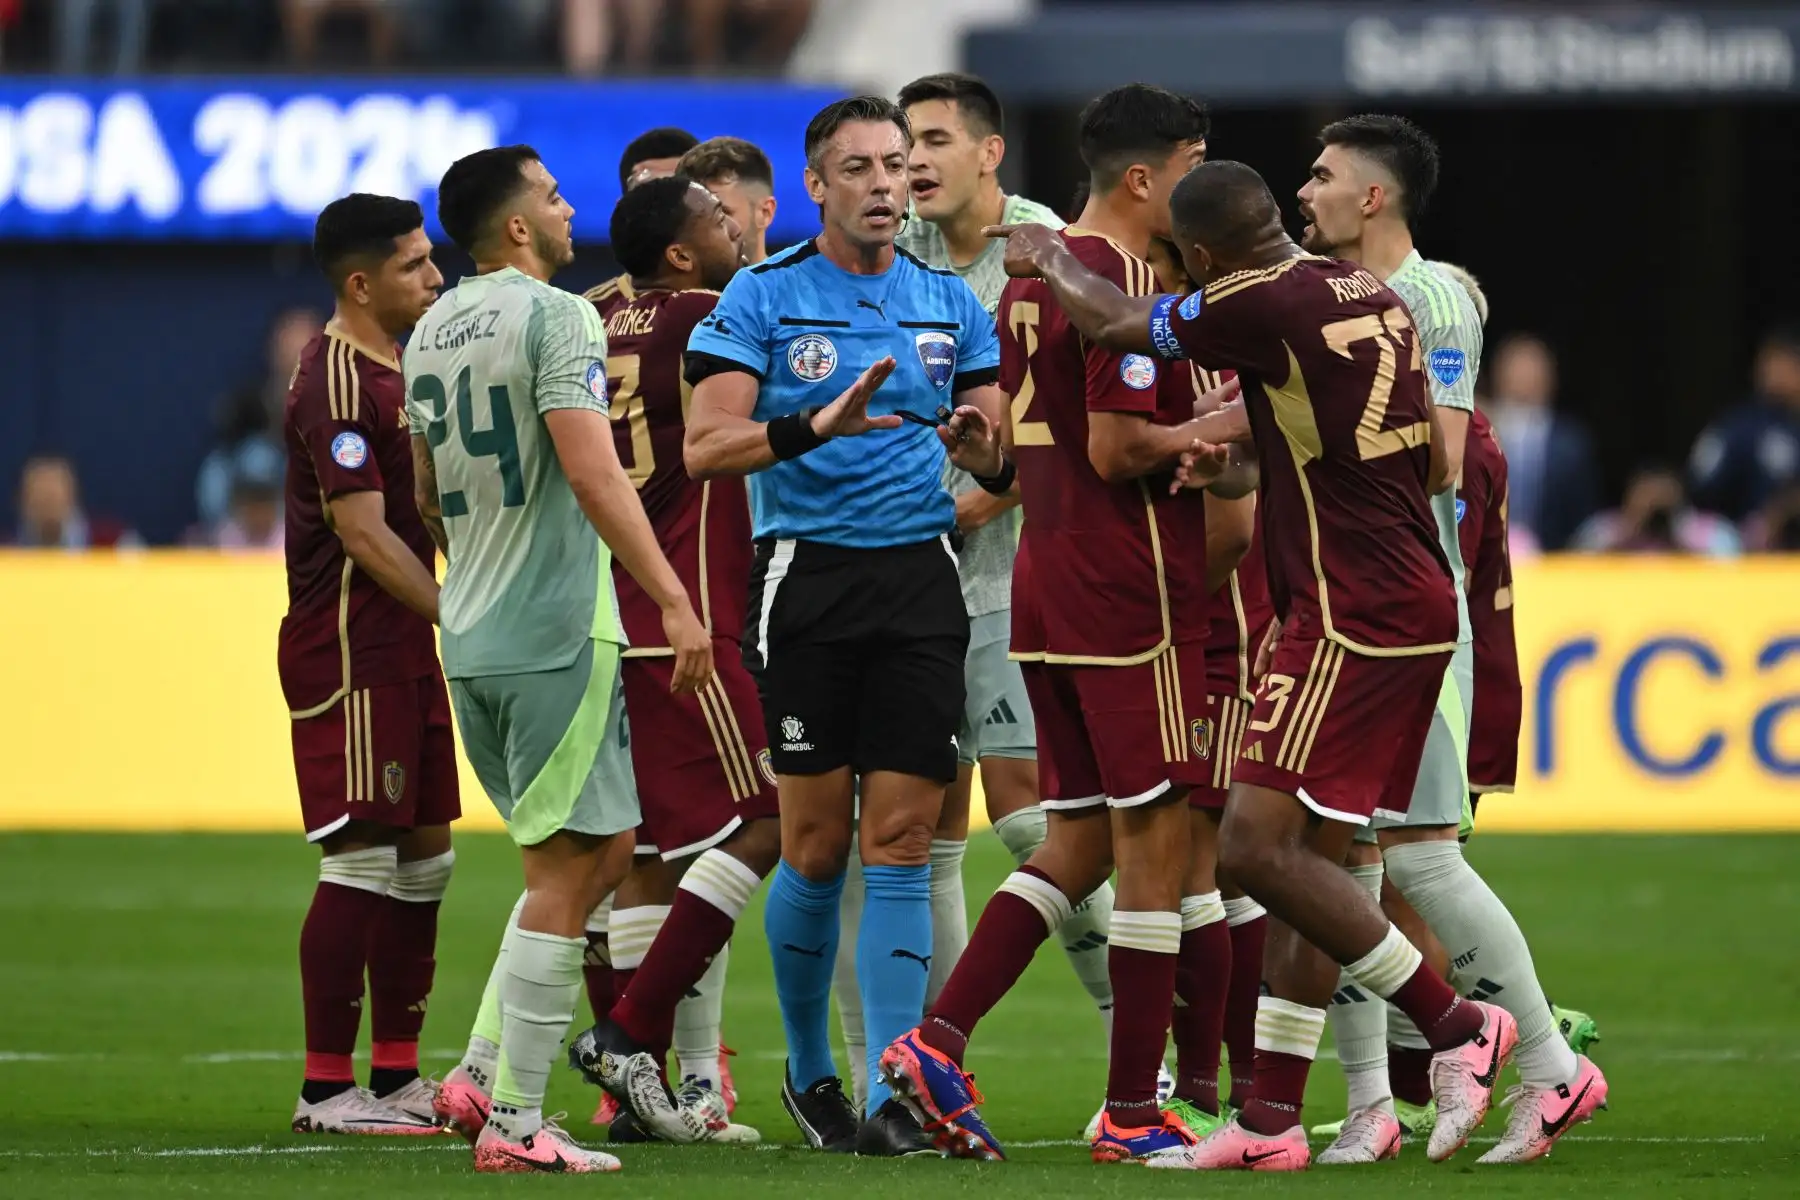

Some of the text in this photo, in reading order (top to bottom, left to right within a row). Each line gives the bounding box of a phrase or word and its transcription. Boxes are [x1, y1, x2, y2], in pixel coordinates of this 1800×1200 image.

[602, 304, 657, 338] RTÍNEZ
[1009, 300, 1056, 447] 2
[1434, 358, 1461, 366] VIBRA
[411, 364, 527, 519] 24
[1247, 673, 1297, 733] 3
[1451, 946, 1478, 970] MF
